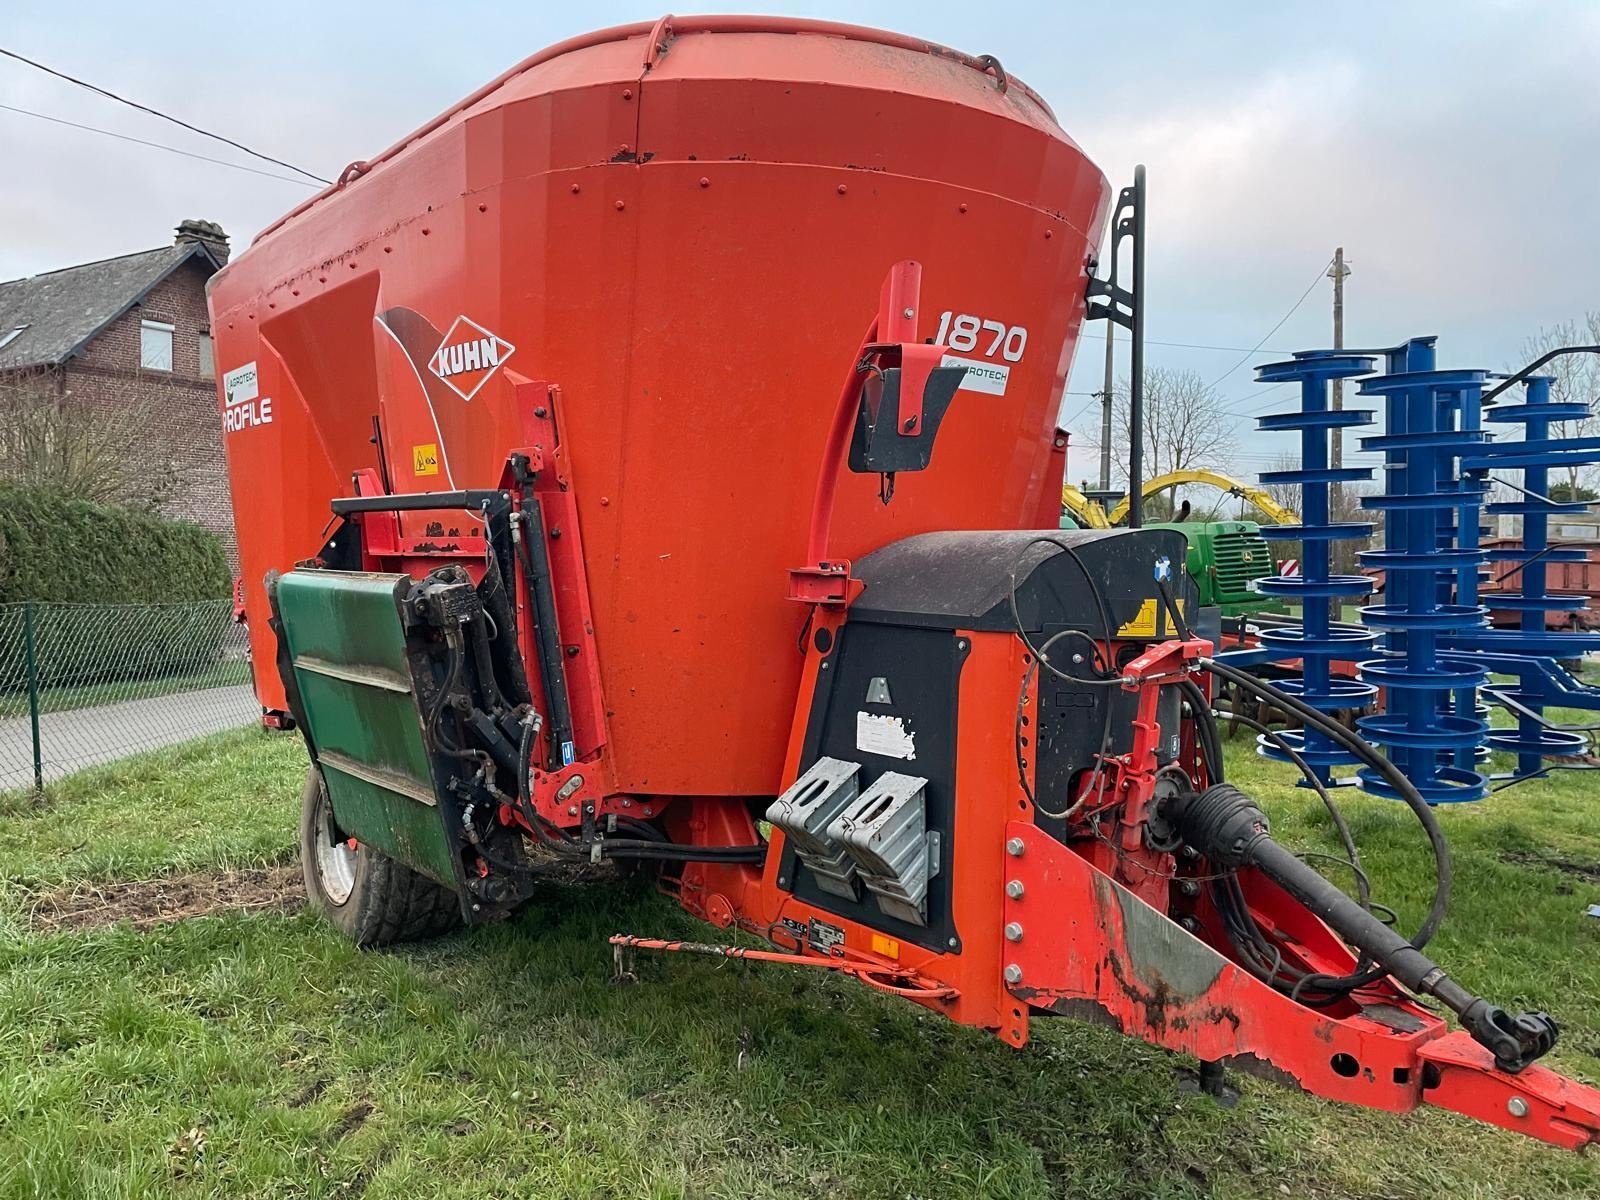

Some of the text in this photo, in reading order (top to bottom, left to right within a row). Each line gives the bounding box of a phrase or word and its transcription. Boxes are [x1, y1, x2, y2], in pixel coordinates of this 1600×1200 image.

[935, 311, 1028, 362] 1870
[438, 336, 499, 377] KUHN
[958, 365, 1007, 381] ROTECH
[229, 370, 256, 388] AGROTECH
[222, 397, 272, 434] PROFILE
